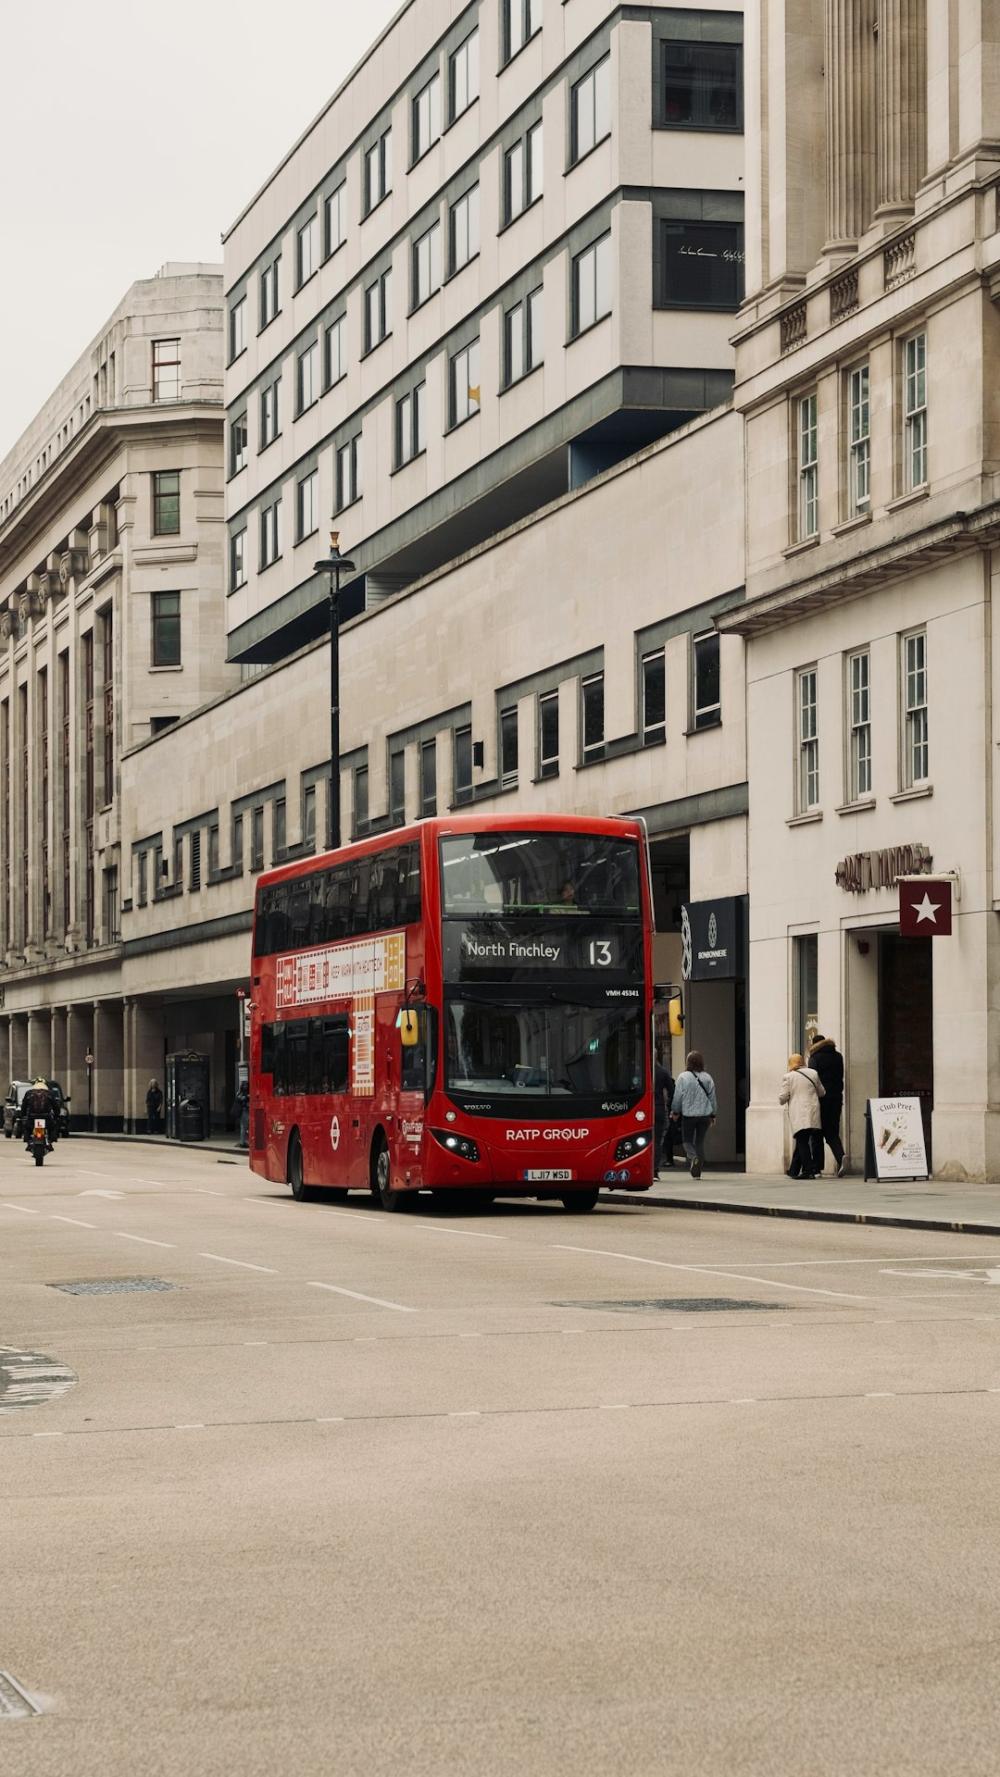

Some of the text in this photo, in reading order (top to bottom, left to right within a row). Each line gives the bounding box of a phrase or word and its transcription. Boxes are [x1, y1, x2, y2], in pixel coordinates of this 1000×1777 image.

[467, 941, 612, 965] North Finchley 13
[605, 989, 640, 997] VMH 45341
[879, 1101, 912, 1112] Club Pret
[506, 1128, 589, 1141] RATP GROUP
[531, 1170, 570, 1180] LJ17 WSD
